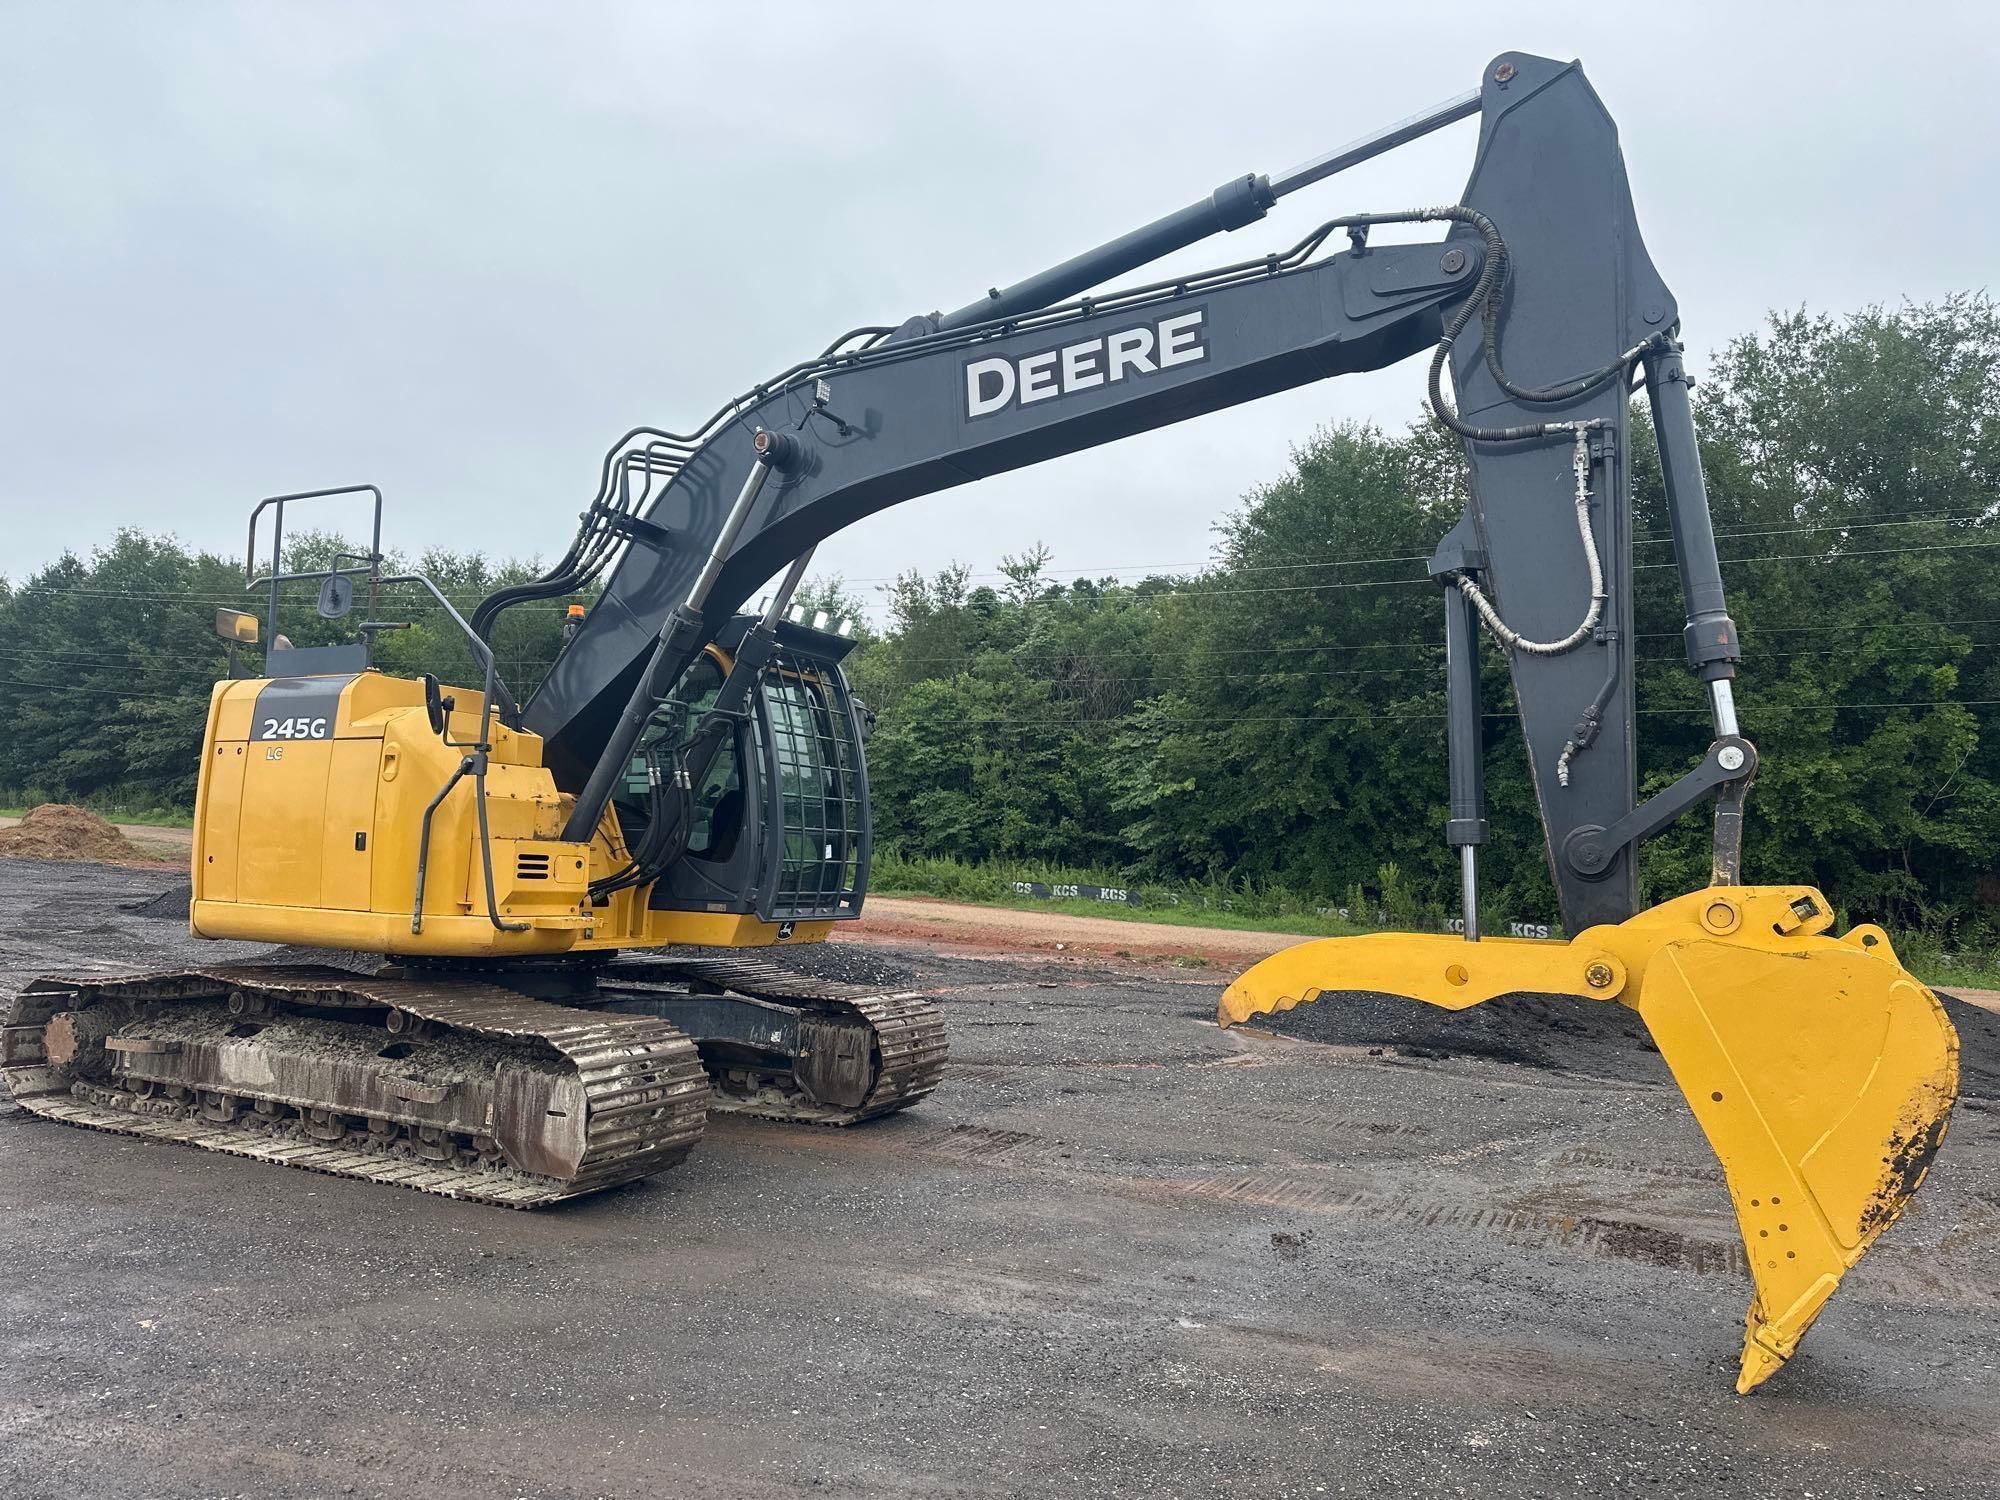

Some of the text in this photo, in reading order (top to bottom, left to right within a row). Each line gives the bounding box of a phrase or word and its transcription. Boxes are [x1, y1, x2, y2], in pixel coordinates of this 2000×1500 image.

[966, 310, 1204, 417] DEERE
[262, 718, 326, 739] 245G
[266, 748, 283, 760] LC
[1053, 884, 1078, 897] KCS
[1100, 887, 1127, 900] KCS
[1444, 918, 1464, 932] KC
[1510, 922, 1548, 938] KCS
